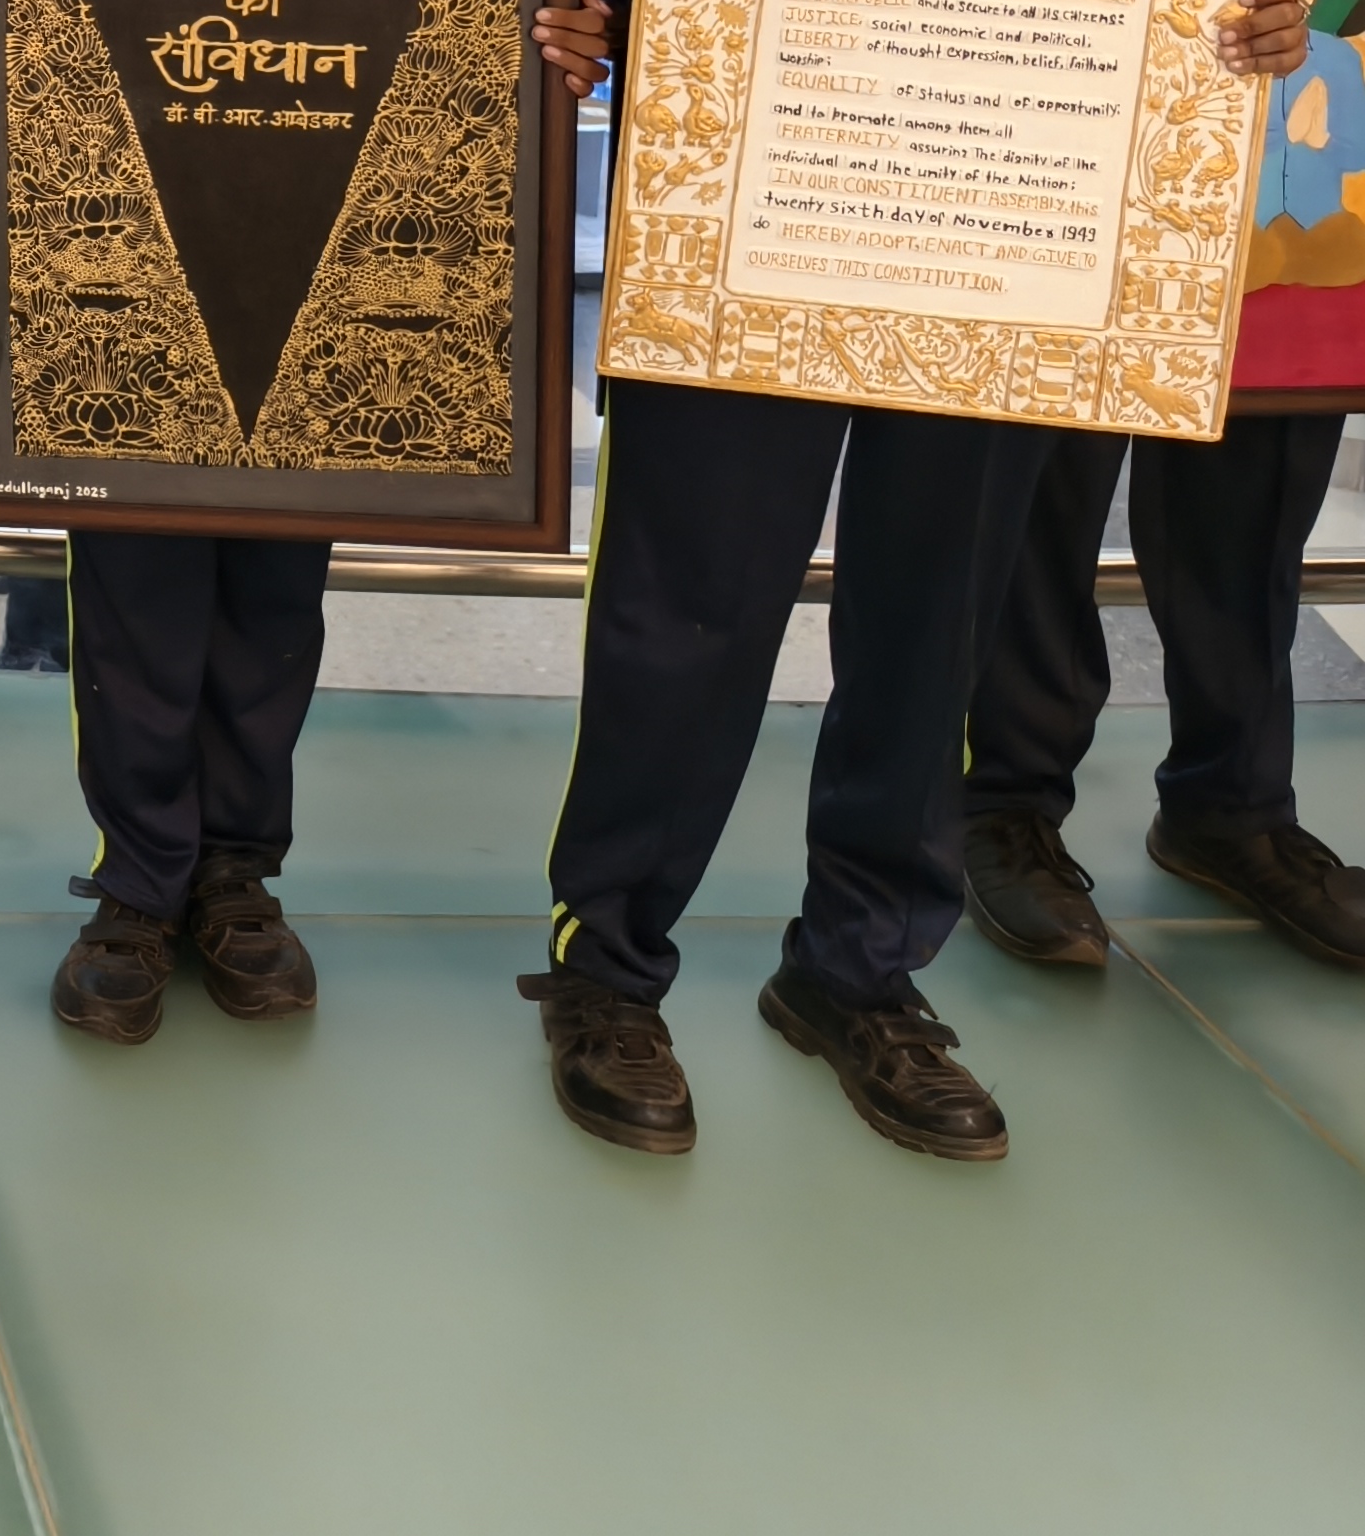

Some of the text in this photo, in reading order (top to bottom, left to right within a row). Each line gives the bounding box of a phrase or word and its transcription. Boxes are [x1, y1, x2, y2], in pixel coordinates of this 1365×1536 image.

[871, 19, 912, 33] social
[921, 24, 987, 38] economic
[996, 30, 1022, 43] and
[146, 15, 367, 93] संविधान
[785, 29, 860, 48] LIBERTY
[867, 40, 881, 52] of
[886, 41, 941, 58] thought
[947, 47, 1019, 66] expression,
[1098, 59, 1118, 73] and
[782, 70, 879, 94] EQUALITY
[896, 84, 914, 97] of
[918, 86, 966, 105] status
[973, 94, 1001, 107] and
[1014, 97, 1030, 108] of
[773, 104, 1013, 139] and to promote among them all
[768, 148, 839, 168] individual
[849, 159, 878, 172] and
[887, 160, 911, 177] the
[918, 166, 957, 181] unity
[965, 169, 979, 182] of
[986, 171, 1009, 185] the
[772, 167, 803, 186] IN
[807, 173, 839, 190] OUR
[843, 176, 984, 204] CONSTITUENT
[1070, 200, 1099, 216] this
[763, 191, 1097, 243] twenty sixth day of November 1949
[753, 215, 770, 230] do
[782, 222, 851, 244] HEREBY
[925, 237, 990, 258] ENACT
[995, 244, 1028, 261] AND
[1032, 248, 1078, 267] GIVE
[1083, 252, 1097, 268] TO
[748, 250, 829, 272] OURSELVES
[833, 259, 870, 278] THIS
[75, 486, 108, 499] 2025
